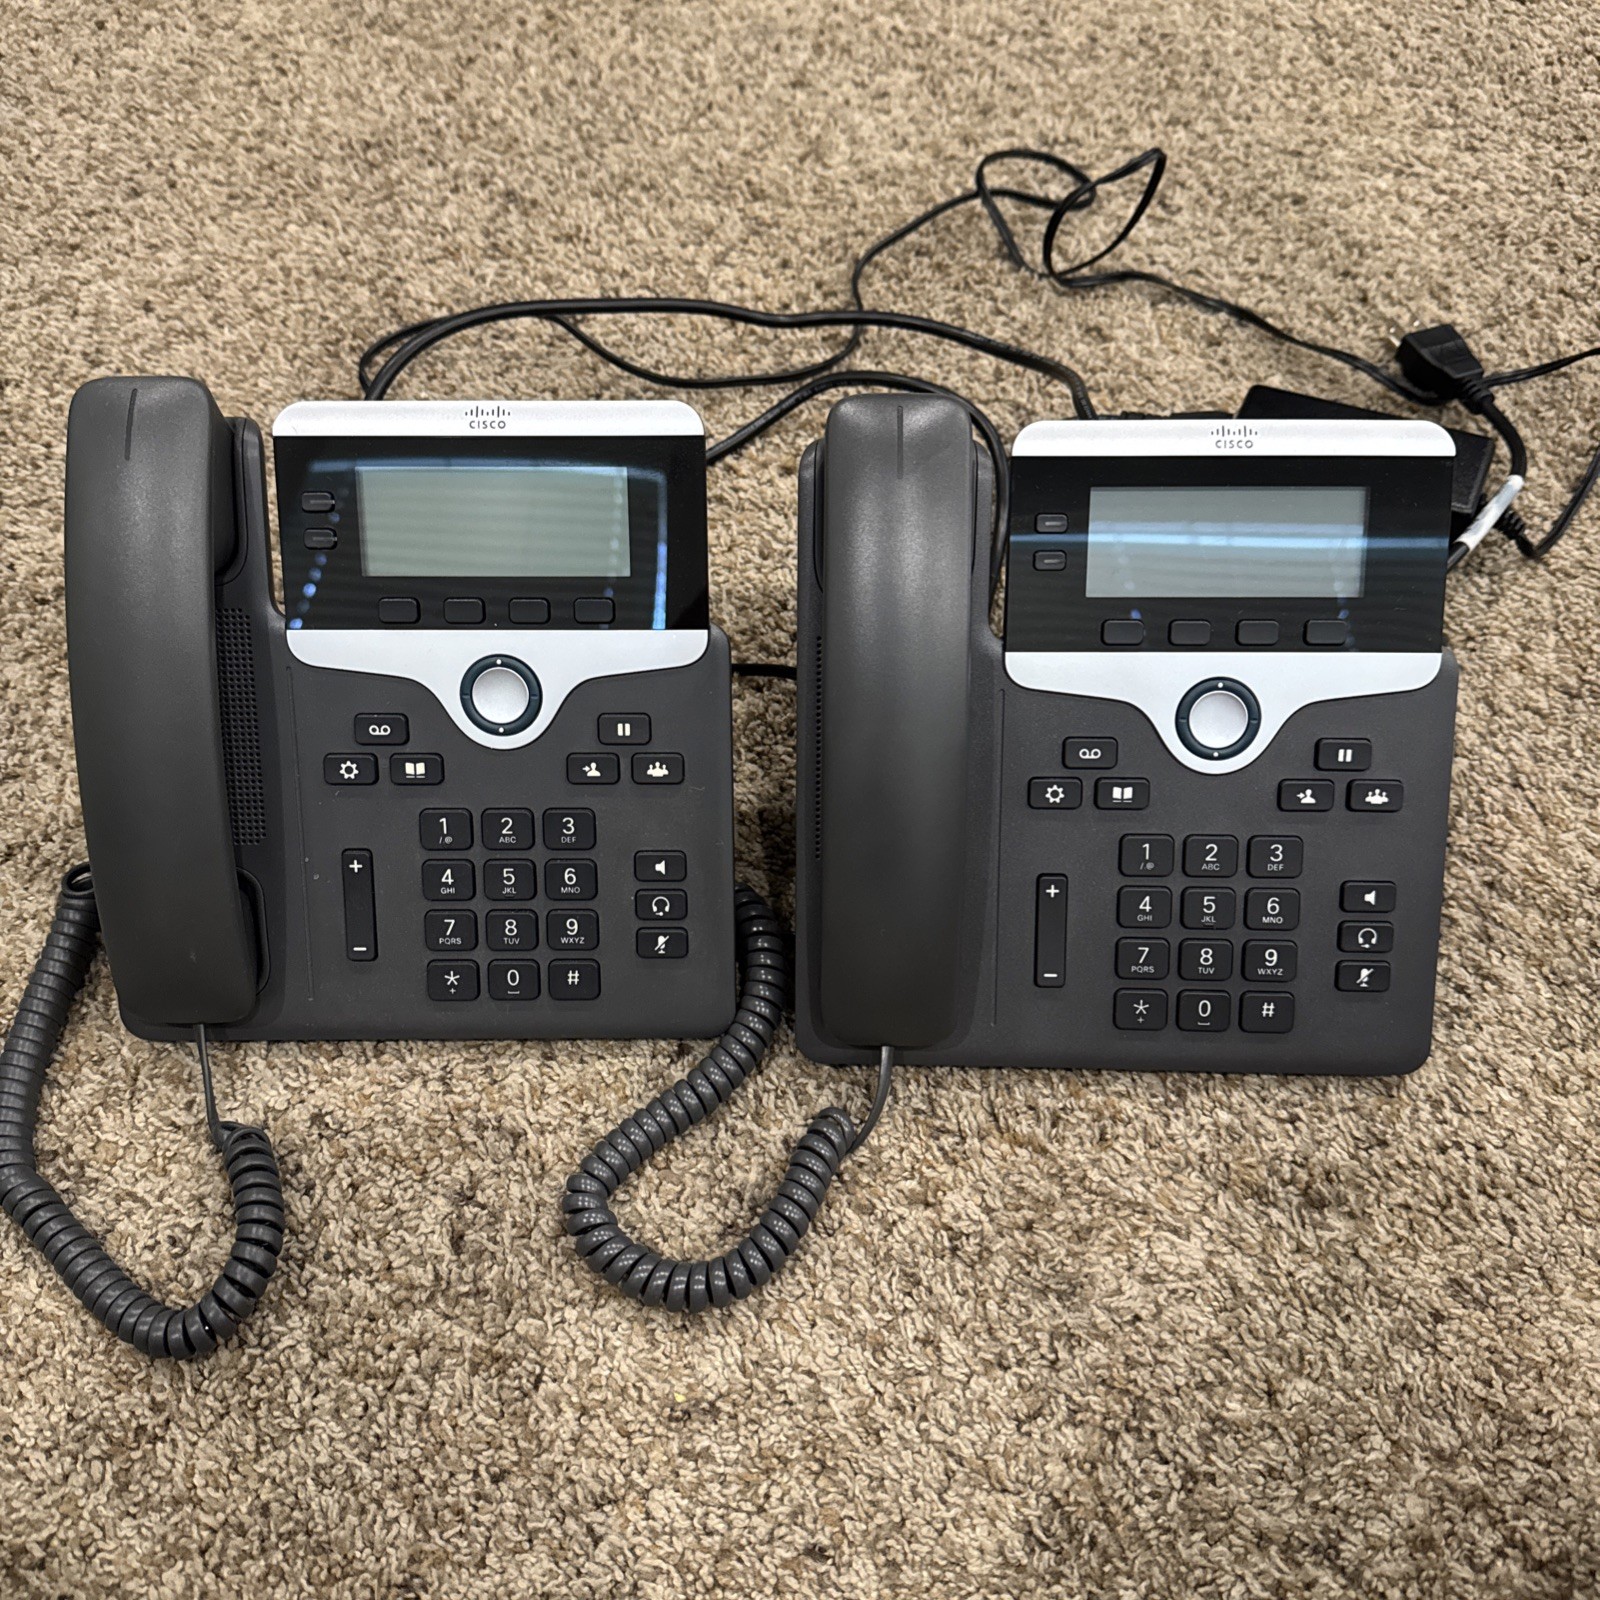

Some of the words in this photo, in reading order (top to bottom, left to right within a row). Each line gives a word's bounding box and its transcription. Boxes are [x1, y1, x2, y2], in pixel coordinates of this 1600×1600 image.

[469, 420, 506, 429] CISCO
[1215, 440, 1254, 449] CISCO
[439, 817, 448, 835] 1
[500, 817, 514, 835] 2
[562, 816, 575, 835] 3
[498, 835, 517, 844] ABC
[560, 836, 577, 844] DEF
[1142, 843, 1150, 861] 1
[1204, 843, 1218, 862] 2
[1269, 843, 1284, 862] 3
[1201, 862, 1221, 871] ABC
[1267, 863, 1284, 872] DEF
[441, 868, 455, 886] 4
[502, 867, 516, 886] 5
[564, 867, 577, 886] 6
[440, 886, 456, 895] GHI
[501, 886, 517, 895] JKL
[560, 886, 581, 894] MNO
[1138, 895, 1152, 913] 4
[1202, 895, 1216, 914] 5
[1266, 896, 1280, 915] 6
[1136, 913, 1153, 922] GHI
[1200, 915, 1217, 923] JKL
[1261, 916, 1284, 924] MNO
[443, 918, 456, 936] 7
[504, 918, 518, 936] 8
[565, 918, 579, 936] 9
[438, 937, 462, 946] PQRS
[503, 937, 520, 945] TUV
[560, 936, 585, 945] WXYZ
[1137, 946, 1150, 964] 7
[1199, 947, 1213, 966] 8
[1264, 948, 1278, 967] 9
[506, 969, 520, 987] 0
[567, 969, 580, 986] #
[1130, 965, 1155, 974] PQRS
[1197, 966, 1215, 975] TUV
[1257, 968, 1284, 976] WXYZ
[1198, 999, 1212, 1018] 0
[1261, 1001, 1275, 1018] #
